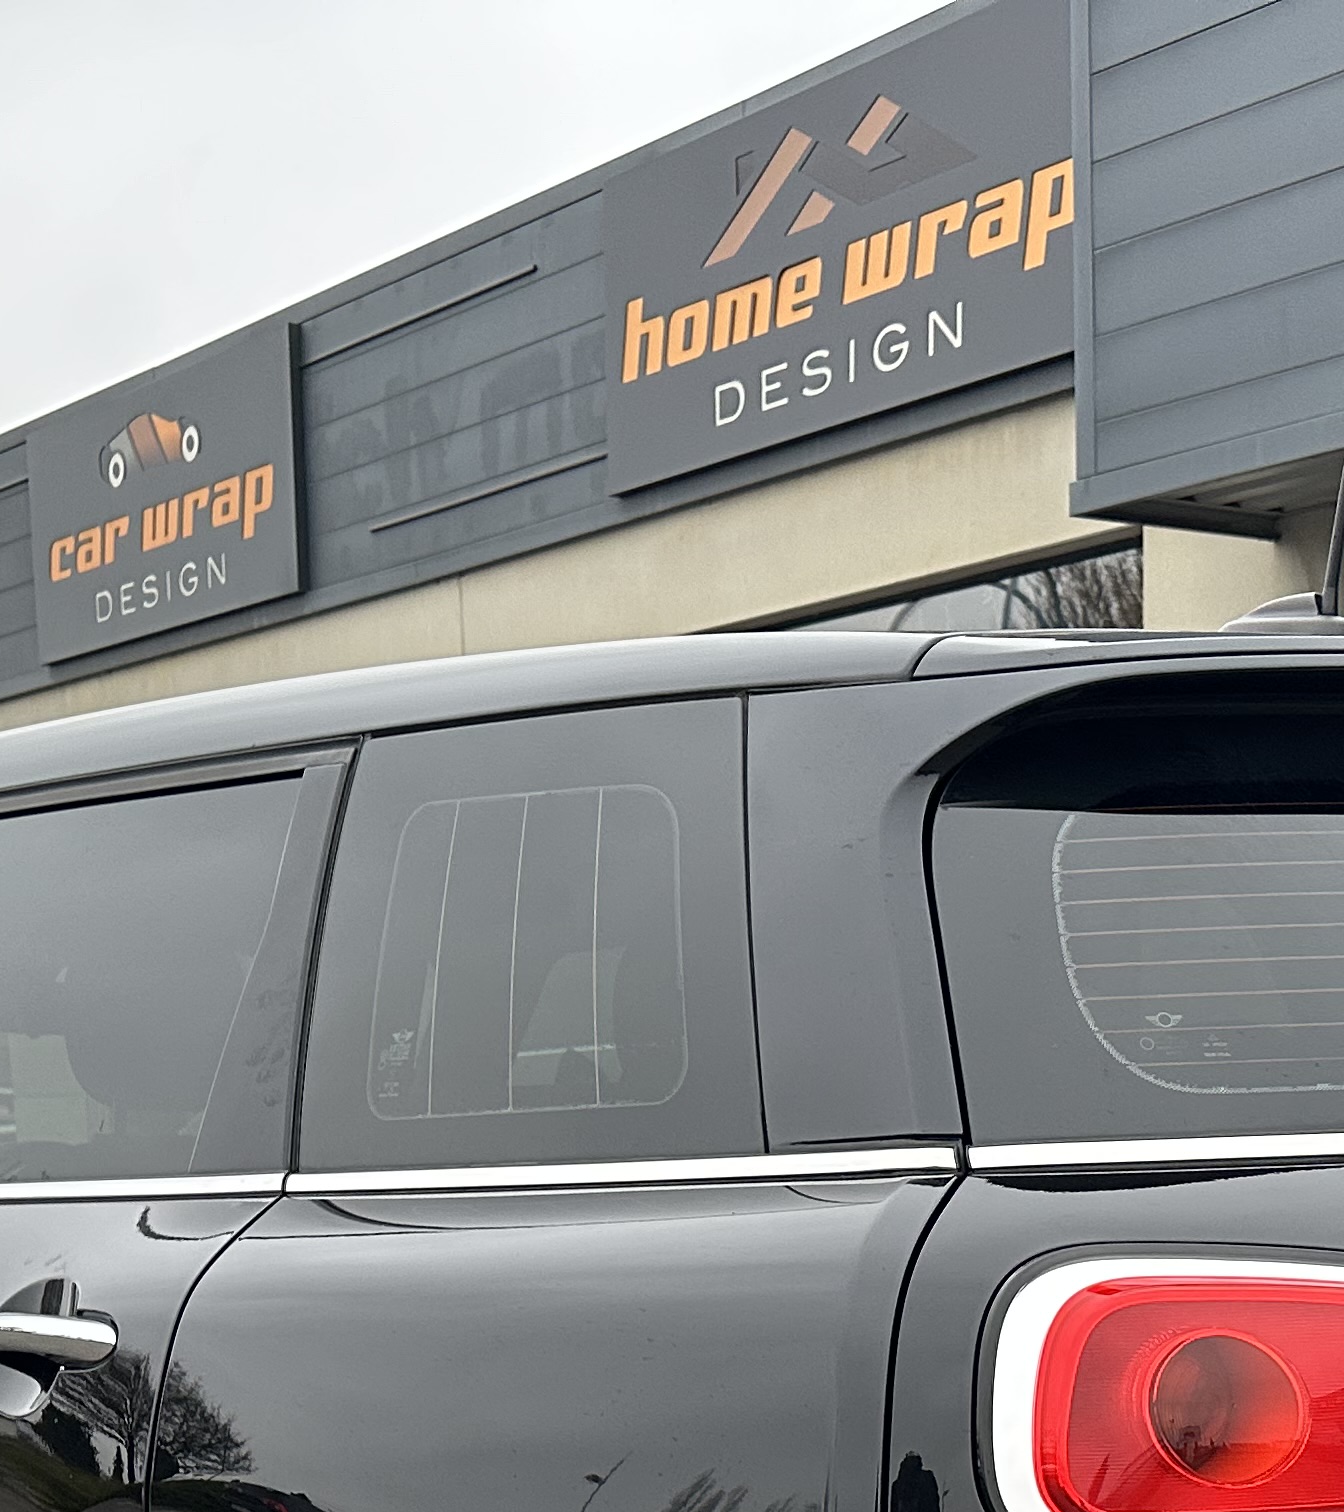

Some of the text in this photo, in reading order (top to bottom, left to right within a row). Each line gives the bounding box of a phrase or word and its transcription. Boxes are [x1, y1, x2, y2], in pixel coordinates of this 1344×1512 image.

[621, 156, 1075, 384] home wrap
[714, 301, 964, 427] DESIGN
[49, 463, 274, 583] car wrap
[95, 552, 227, 624] DESIGN
